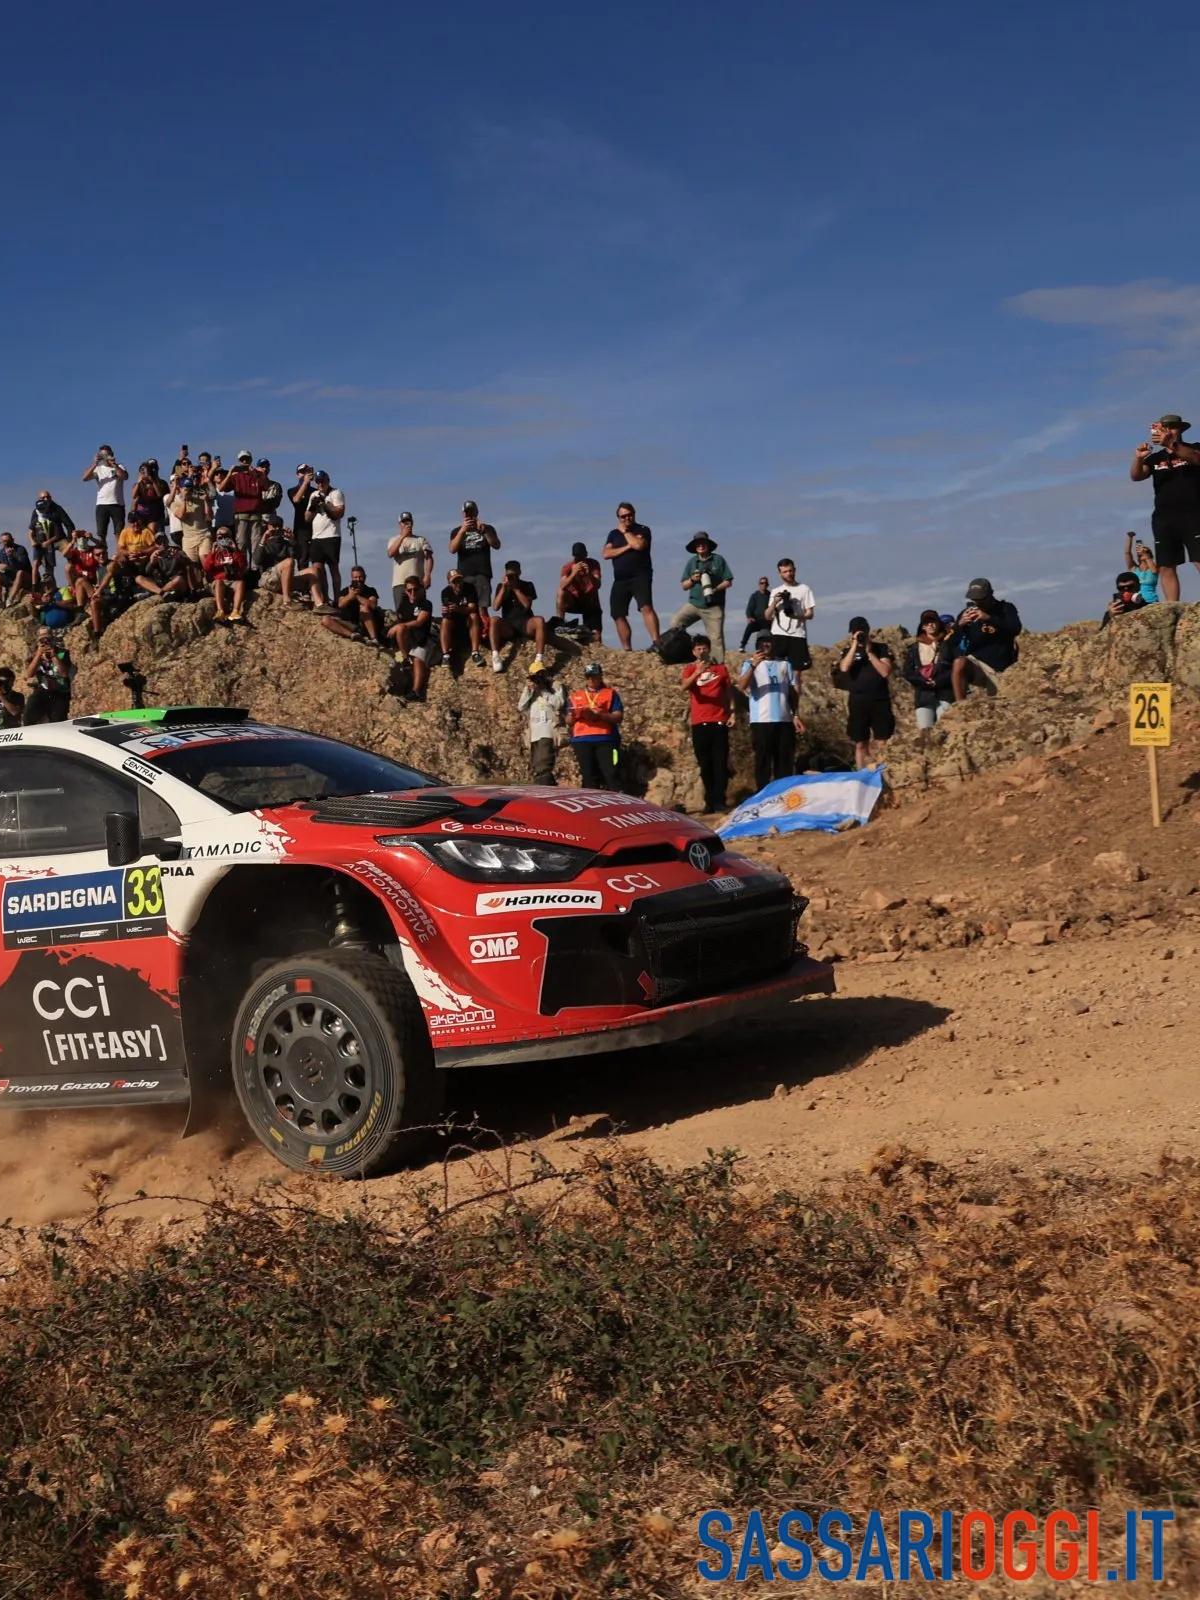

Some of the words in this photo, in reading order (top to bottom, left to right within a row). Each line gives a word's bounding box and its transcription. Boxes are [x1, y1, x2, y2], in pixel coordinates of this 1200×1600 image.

[125, 757, 158, 781] CENTRAL
[186, 840, 262, 859] TAMADIC
[160, 866, 195, 877] PIAA
[7, 885, 117, 915] SARDEGNA
[127, 867, 163, 916] 33
[341, 862, 429, 944] AUTOMOTIVE
[353, 859, 438, 937] Panasonic
[469, 936, 519, 958] OMP
[8, 1084, 59, 1093] TOYOTA
[60, 1082, 110, 1091] GAZOO
